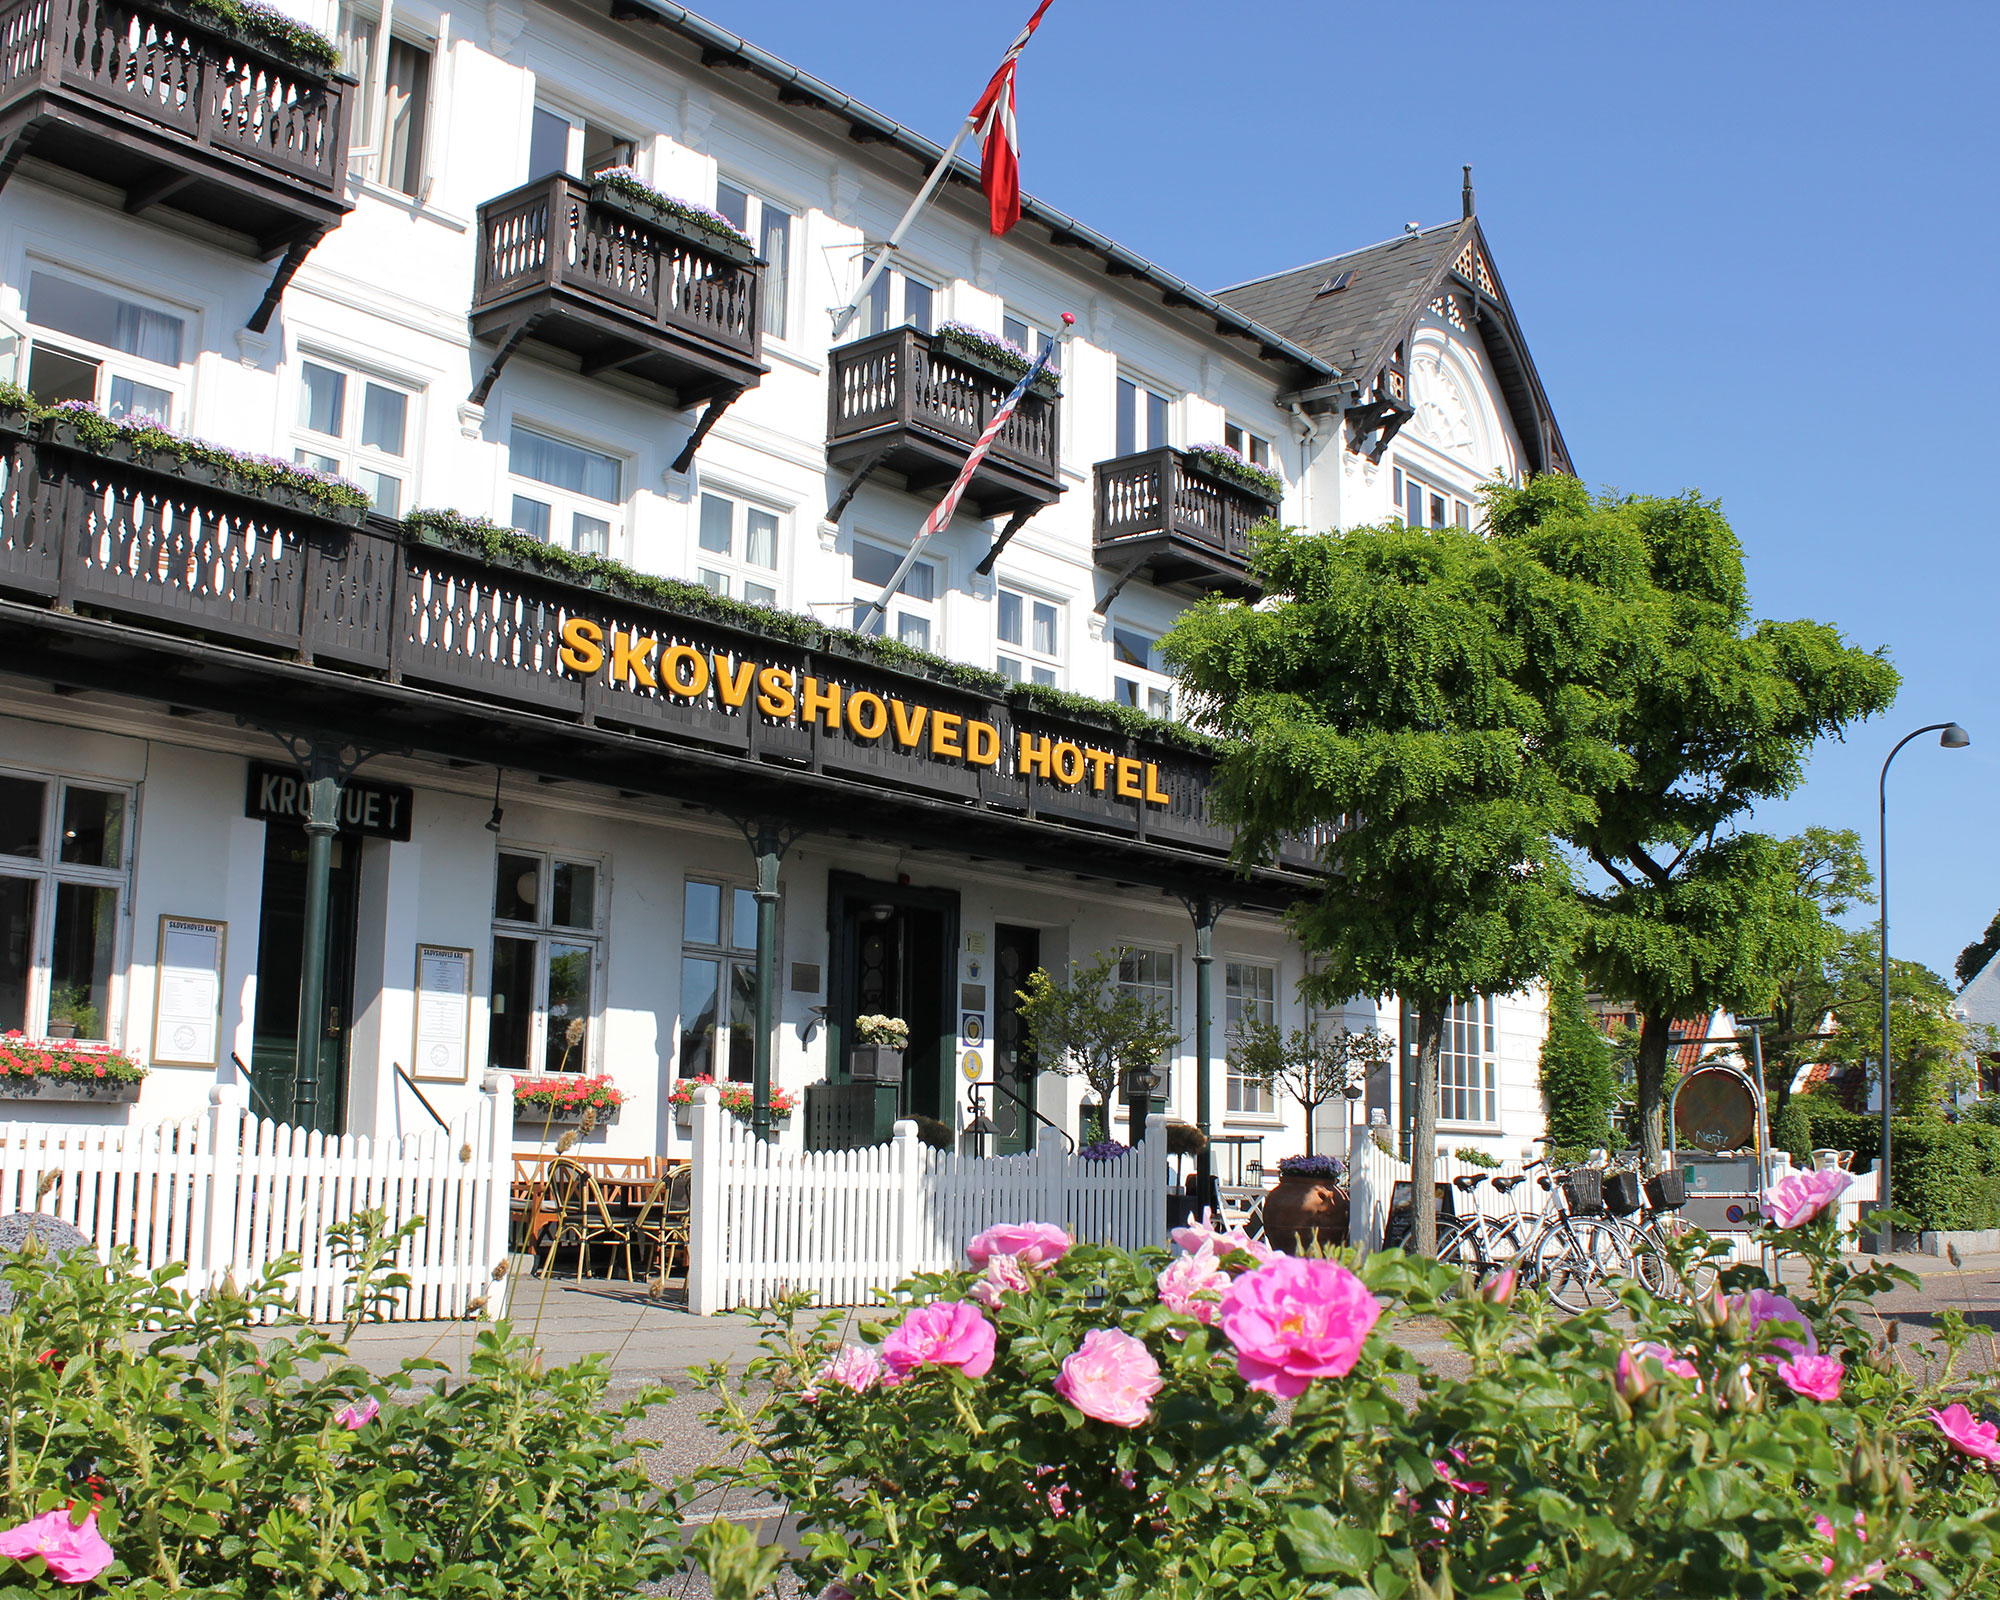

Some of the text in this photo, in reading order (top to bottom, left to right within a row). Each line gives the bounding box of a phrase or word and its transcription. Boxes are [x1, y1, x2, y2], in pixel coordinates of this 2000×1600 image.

[560, 617, 1170, 805] SKOVSHOVED HOTEL
[259, 773, 381, 827] KROTUE
[169, 921, 217, 933] SKOVSHOVED KRO
